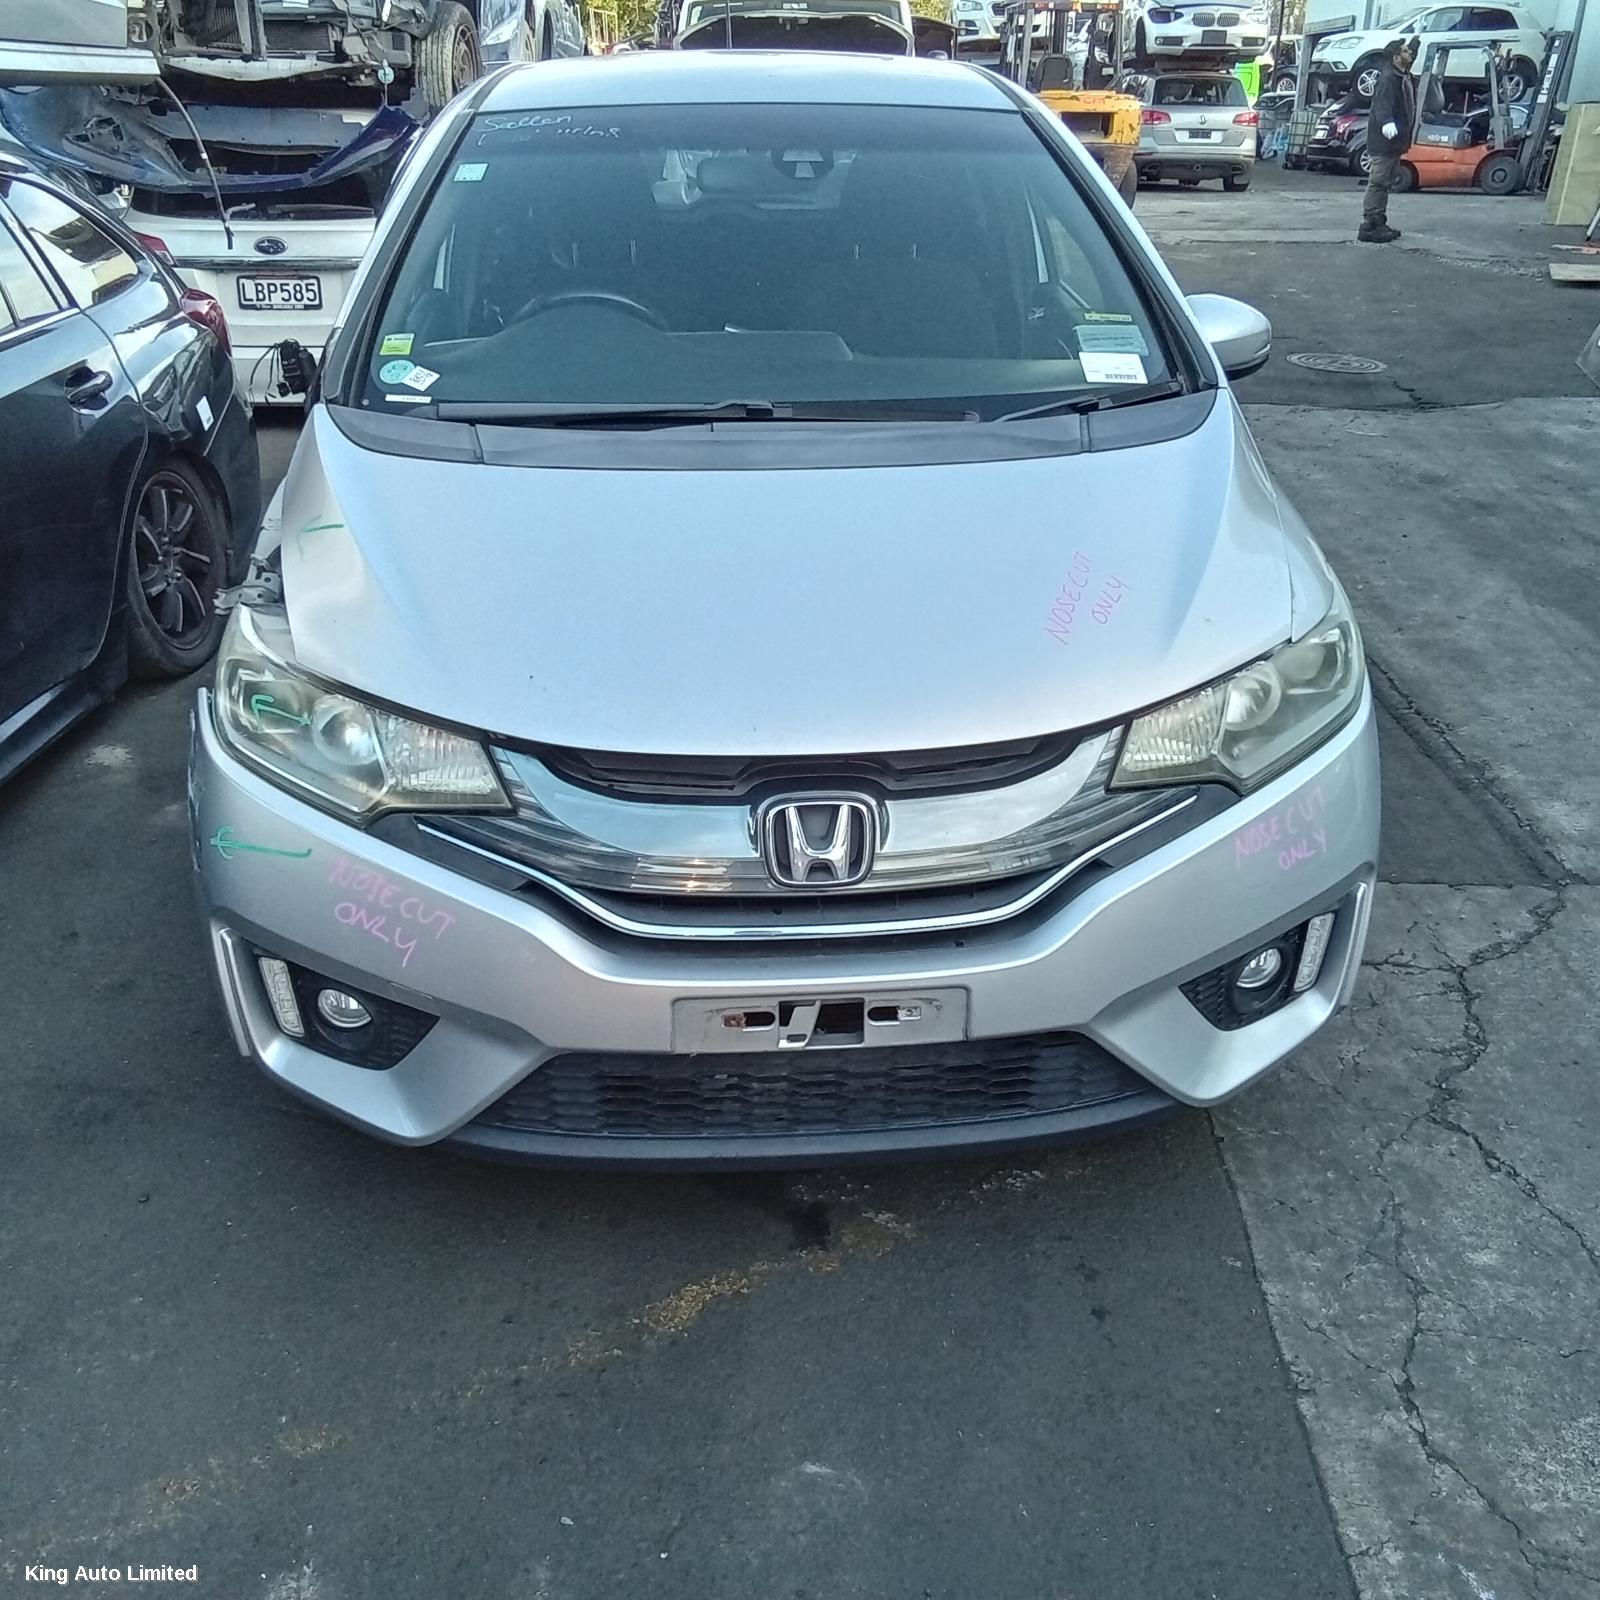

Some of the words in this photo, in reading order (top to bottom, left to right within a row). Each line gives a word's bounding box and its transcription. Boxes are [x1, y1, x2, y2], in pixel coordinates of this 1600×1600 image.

[241, 282, 318, 302] LBP585
[1091, 574, 1131, 625] ONLY
[1279, 828, 1328, 870] ONLY
[335, 902, 417, 967] ONLY
